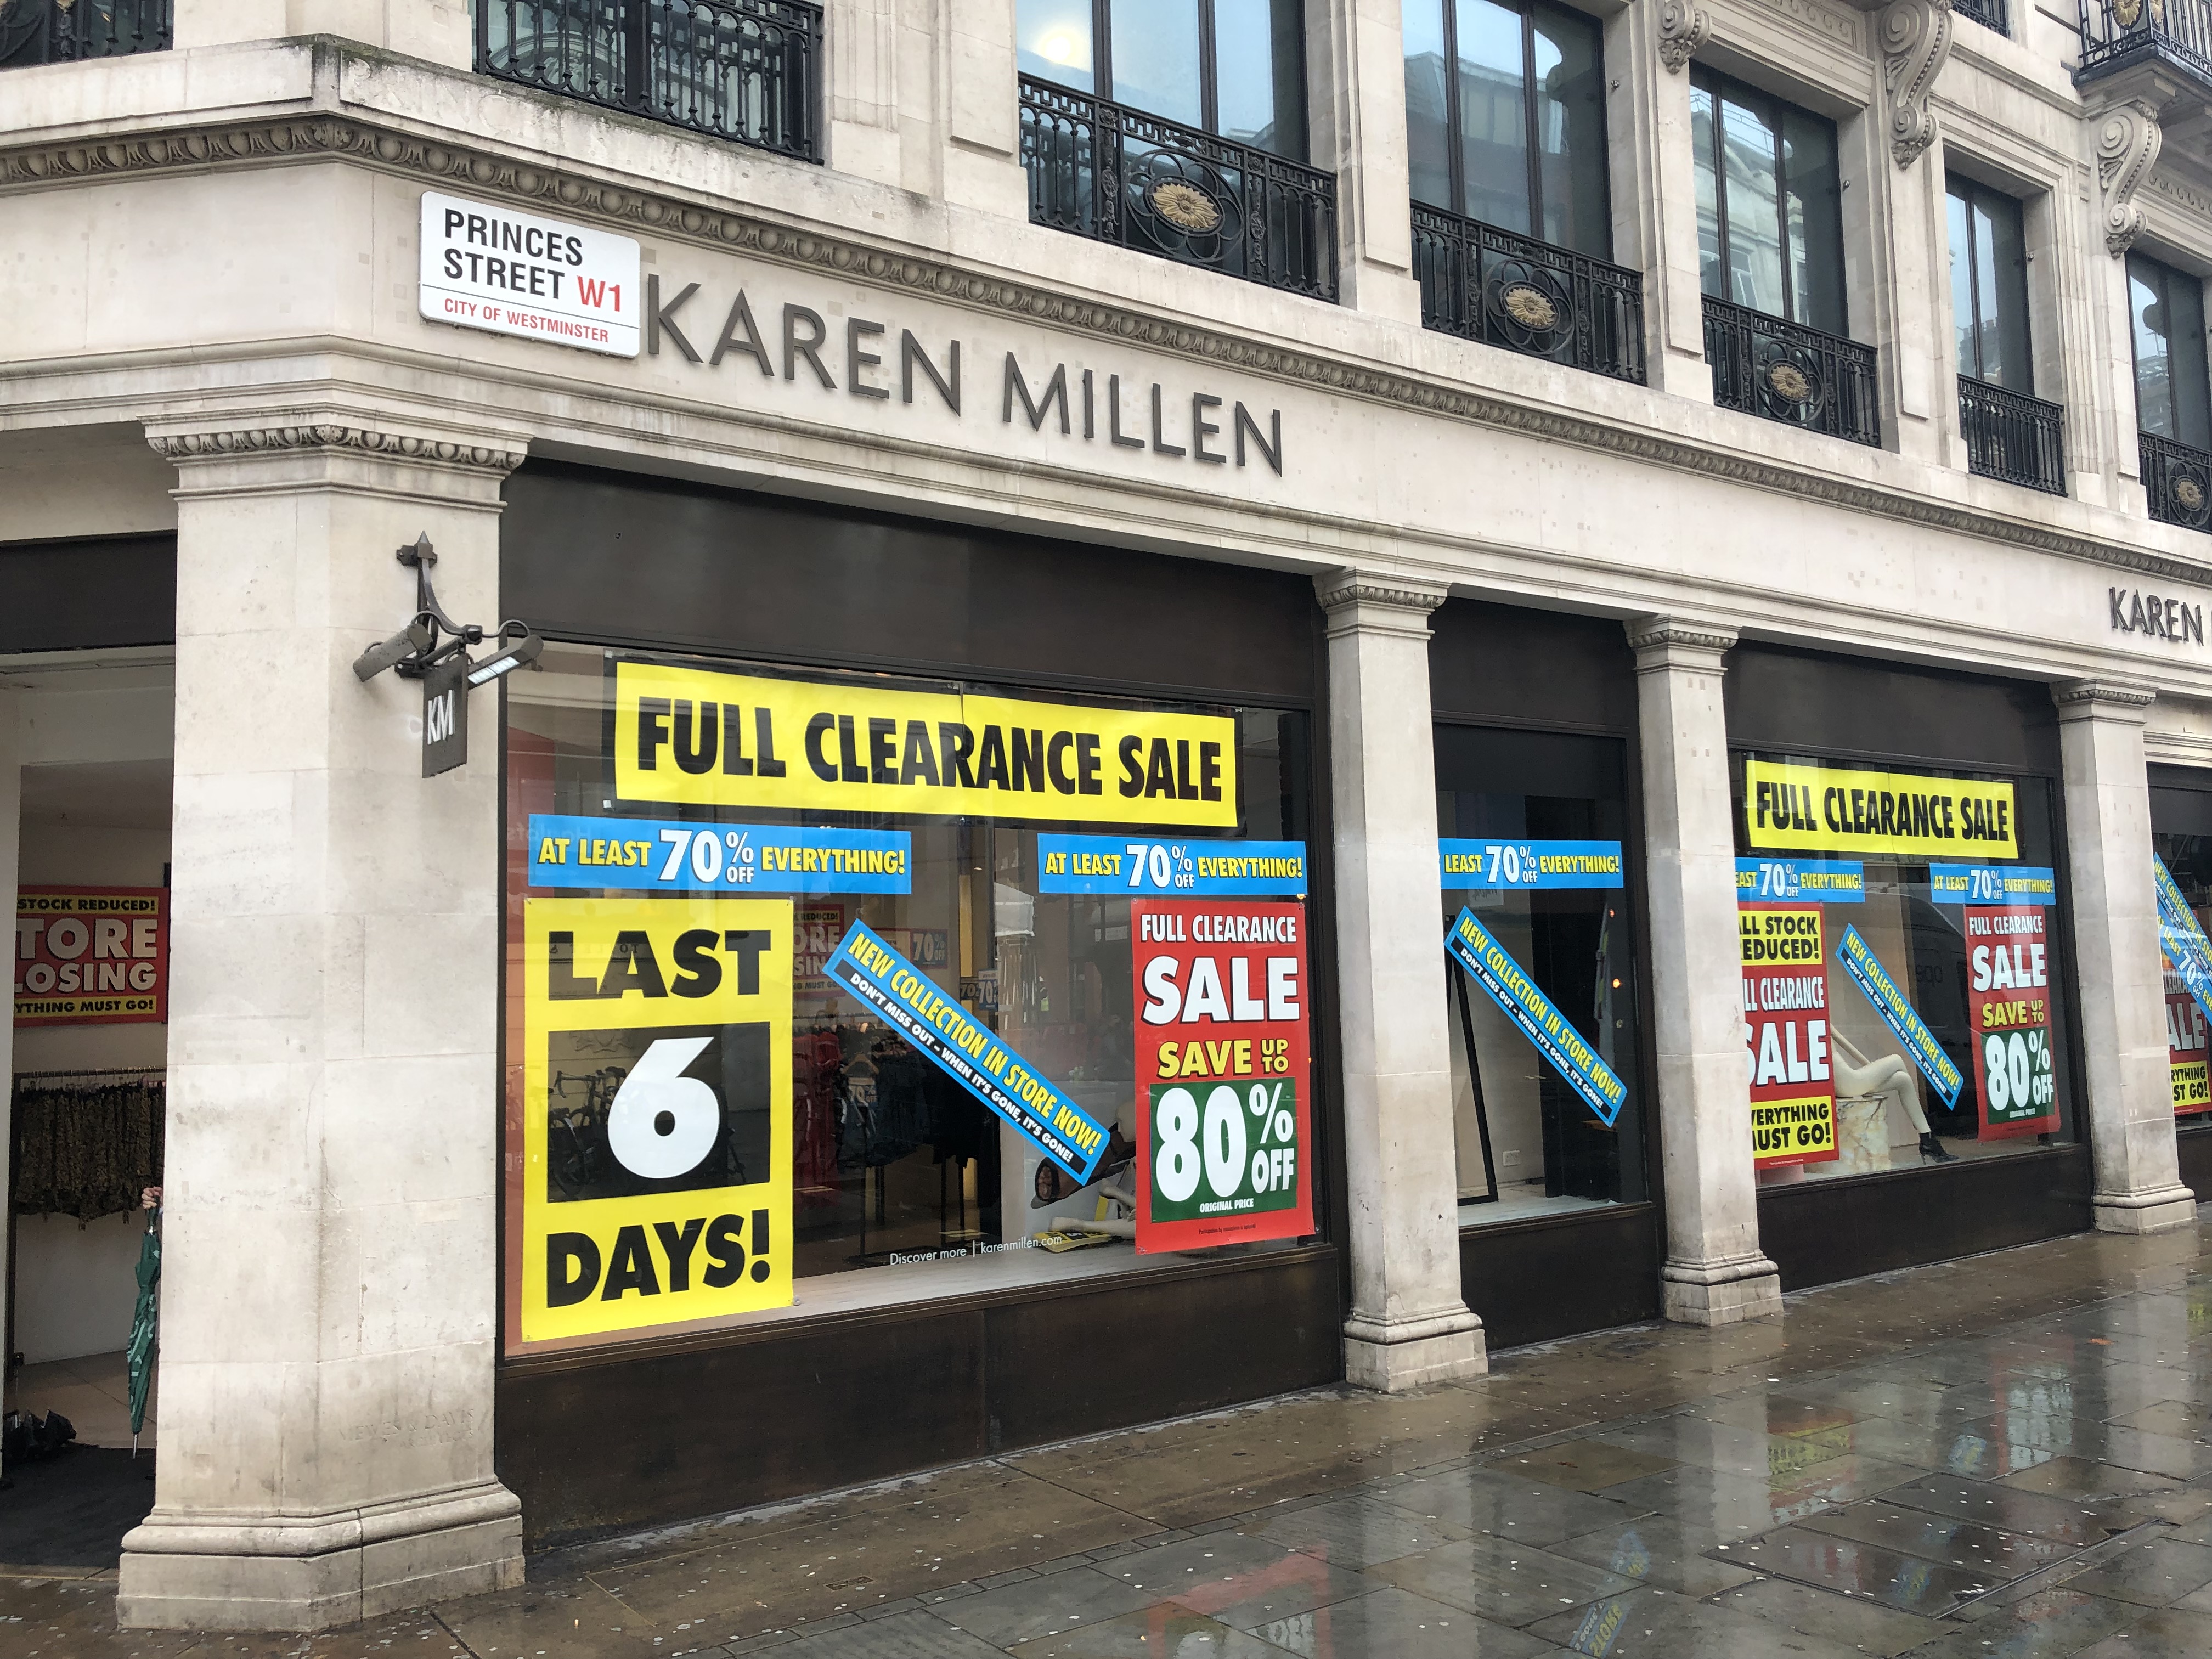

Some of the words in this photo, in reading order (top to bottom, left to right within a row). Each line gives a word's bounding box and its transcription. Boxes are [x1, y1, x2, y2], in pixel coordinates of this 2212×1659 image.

[445, 208, 583, 266] PRINCES
[444, 250, 565, 300] STREET
[577, 275, 621, 312] W1
[444, 298, 478, 317] CITY
[483, 306, 501, 321] OF
[507, 309, 609, 343] WESTMINSTER
[648, 274, 961, 417] KAREN
[1003, 351, 1282, 477] MILLEN
[2109, 586, 2204, 646] KAREN
[428, 690, 454, 744] KM
[637, 697, 786, 778] FULL
[804, 712, 1102, 796] CLEARANCE
[1118, 734, 1222, 803] SALE
[1757, 781, 1817, 832] FULL
[1825, 787, 1955, 839] CLEARANCE
[1960, 797, 2009, 842] SALE
[538, 838, 569, 865] AT
[578, 839, 652, 867] LEAST
[726, 867, 754, 883] OFF
[761, 847, 905, 874] EVERYTHING!
[1045, 852, 1066, 874] AT
[1072, 853, 1121, 876] LEAST
[1174, 874, 1194, 888] OFF
[1198, 857, 1302, 878] EVERYTHING!
[1444, 854, 1482, 873] LEAST
[1522, 871, 1538, 884] OFF
[1539, 855, 1620, 874] EVERYTHING!
[1736, 871, 1757, 888] EAST
[1787, 887, 1799, 896] OFF
[1801, 873, 1862, 889] EVERYTHING!
[1934, 876, 1943, 890] AT
[1946, 876, 1969, 891] LEAST
[1993, 890, 2002, 900] OFF
[2004, 877, 2053, 894] EVERYTHING!
[18, 898, 72, 910] STOCK
[78, 899, 155, 911] REDUCED!
[16, 918, 157, 959] TORE
[794, 926, 839, 953] ORE
[1141, 915, 1186, 942] FULL
[1192, 915, 1296, 943] CLEARANCE
[1739, 916, 1760, 935] LL
[1765, 916, 1818, 935] STOCK
[1969, 916, 1991, 936] FULL
[1993, 915, 2043, 934] CLEARANCE
[549, 929, 771, 1001] LAST
[1742, 938, 1819, 960] EDUCED!
[2202, 941, 2212, 964] STO
[14, 962, 157, 994] OSING
[1972, 943, 2047, 992] SALE
[16, 1002, 75, 1013] YTHING
[80, 1001, 121, 1012] MUST
[126, 1000, 153, 1010] GO!
[1142, 956, 1300, 1025] SALE
[1743, 978, 1758, 1011] LL
[1760, 977, 1825, 1012] CLEARANCE
[1861, 978, 1875, 995] MISS
[1874, 994, 1884, 1008] OUT
[2031, 1000, 2044, 1012] UP
[1459, 917, 1488, 953] NEW
[1486, 947, 1548, 1021] COLLECTION
[1545, 1012, 1561, 1036] IN
[1558, 1028, 1593, 1072] STORE
[1590, 1063, 1622, 1104] NOW!
[1460, 947, 1483, 974] DON'T
[1482, 972, 1499, 993] MISS
[1499, 991, 1514, 1008] OUT
[1518, 1011, 1538, 1036] WHEN
[1583, 1084, 1604, 1109] GONE!
[1846, 932, 1866, 962] NEW
[1865, 957, 1908, 1019] COLLECTION
[1906, 1013, 1917, 1032] IN
[1915, 1026, 1939, 1063] STORE
[1937, 1056, 1960, 1091] NOW!
[1982, 1001, 2028, 1028] SAVE
[2032, 1012, 2044, 1023] TO
[2166, 1002, 2205, 1051] ALE
[848, 932, 895, 979] NEW
[891, 969, 988, 1059] COLLECTION
[982, 1045, 1008, 1076] IN
[1003, 1064, 1058, 1118] STORE
[1053, 1104, 1102, 1155] NOW!
[1158, 1039, 1252, 1079] SAVE
[1261, 1039, 1288, 1056] UP
[850, 973, 887, 1006] DON'T
[884, 1001, 912, 1027] MISS
[912, 1025, 935, 1046] OUT
[941, 1047, 974, 1079] WHEN
[971, 1073, 992, 1094] IT'S
[1022, 1116, 1042, 1136] IT'S
[1042, 1132, 1074, 1163] GONE!
[1262, 1057, 1288, 1073] TO
[2171, 1066, 2205, 1081] RYTHING
[607, 1036, 720, 1178] 6
[2033, 1074, 2053, 1105] OFF
[2174, 1084, 2186, 1101] ST
[2190, 1081, 2208, 1099] GO!
[1752, 1127, 1790, 1151] UST
[1797, 1122, 1831, 1146] GO!
[1251, 1148, 1295, 1194] OFF
[1200, 1200, 1232, 1213] ORIGINAL
[1234, 1198, 1254, 1209] PRICE
[547, 1209, 770, 1308] DAYS!
[890, 1252, 936, 1266] Discover
[940, 1249, 966, 1259] more
[981, 1236, 1062, 1254] karenmillen.com
